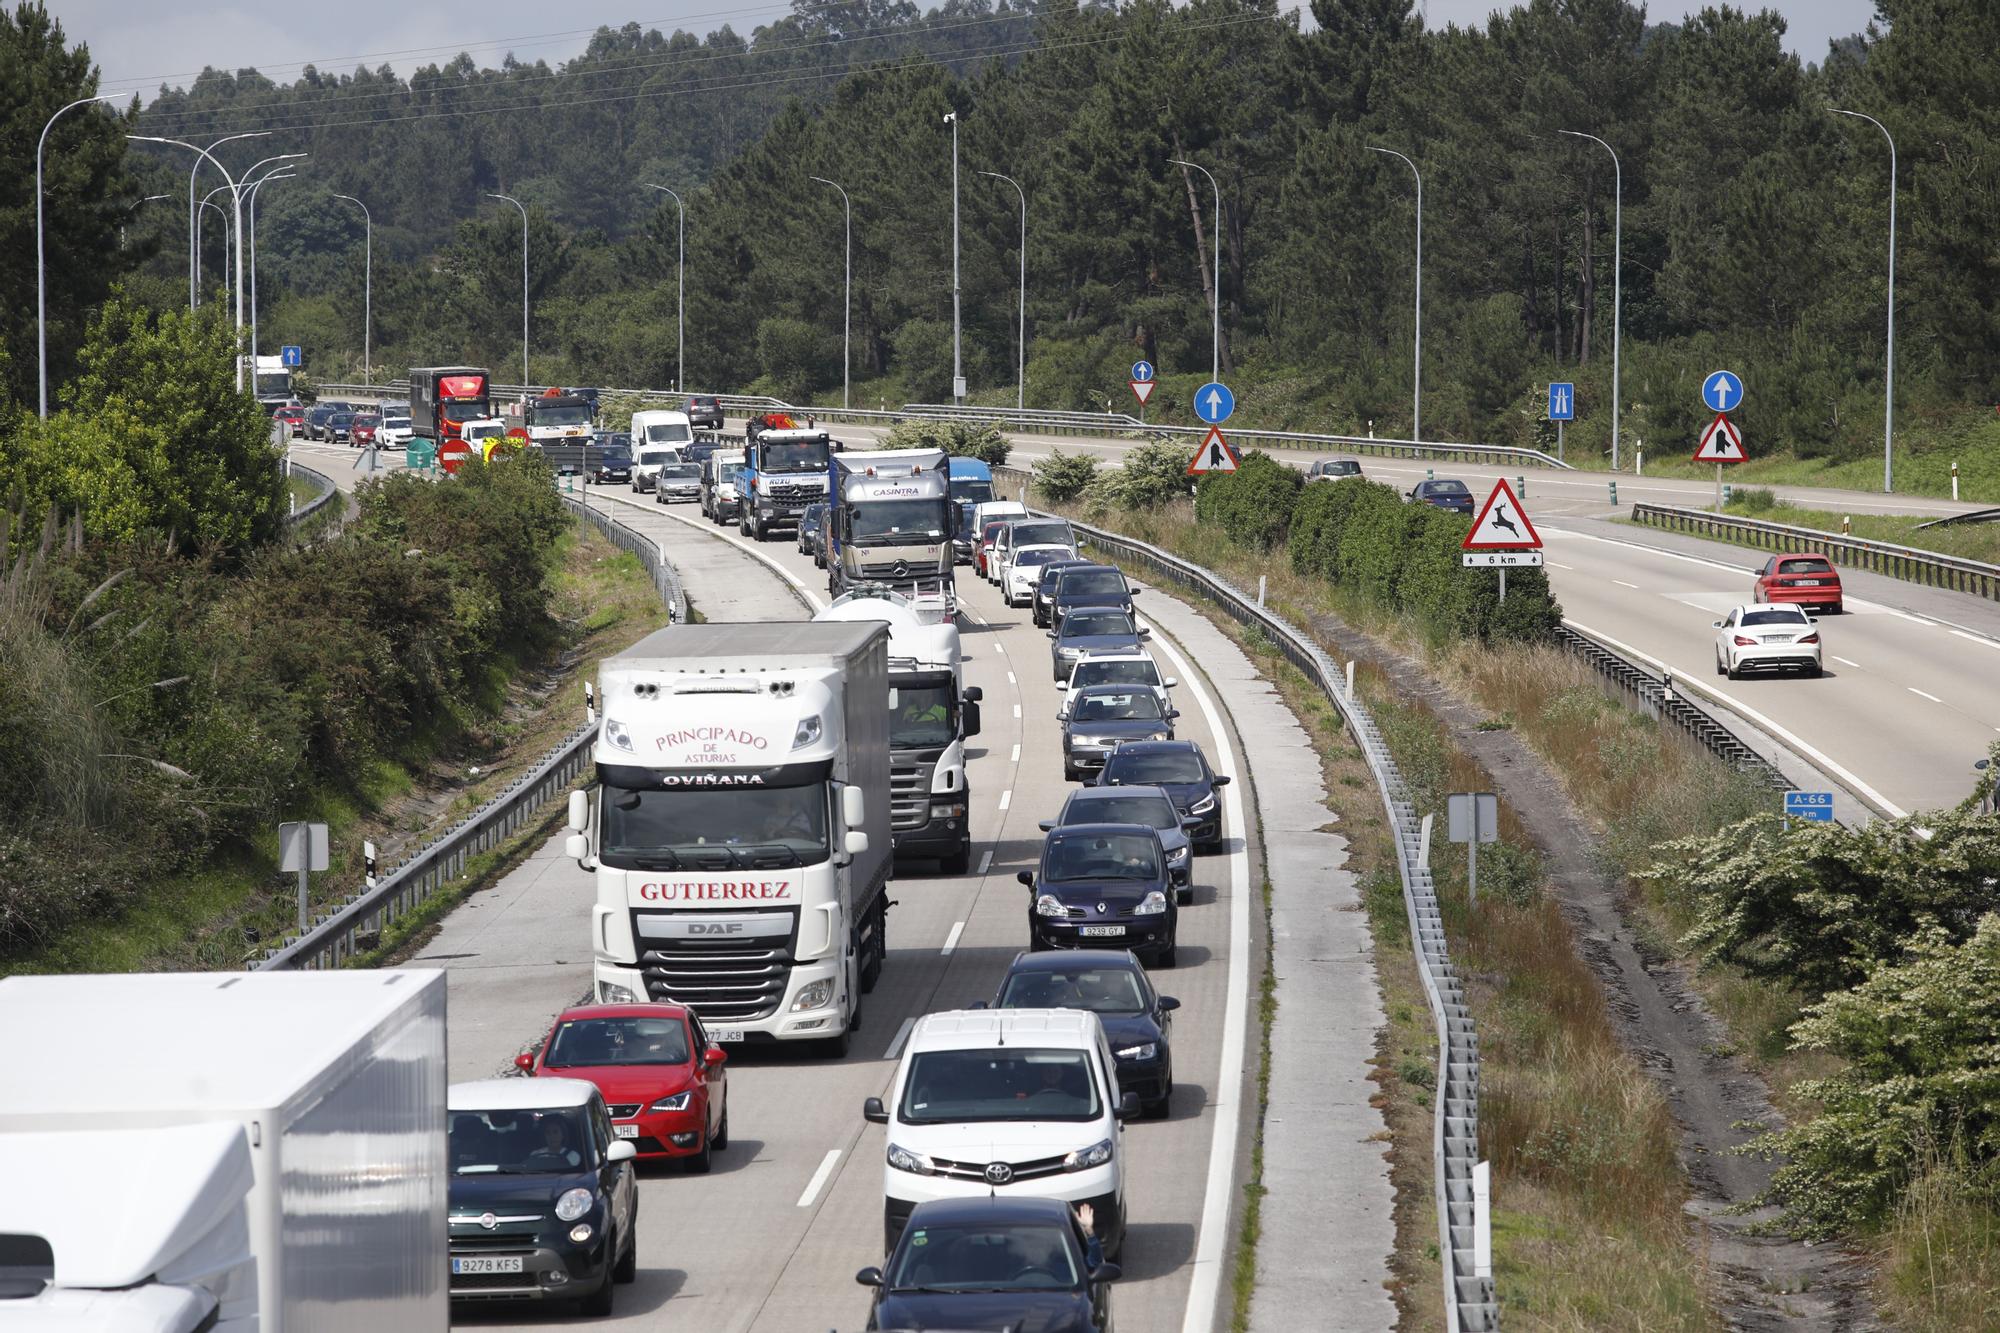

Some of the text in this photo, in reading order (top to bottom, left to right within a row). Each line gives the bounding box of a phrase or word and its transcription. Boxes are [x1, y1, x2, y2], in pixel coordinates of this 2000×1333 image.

[873, 488, 919, 496] CASINTRA
[1489, 556, 1517, 564] 6 km
[656, 727, 768, 751] PRINCIPADO
[703, 743, 718, 753] DE
[685, 754, 737, 763] ASTURIAS
[663, 773, 765, 786] OVIÑANA
[1794, 794, 1826, 804] A-66
[1803, 810, 1817, 818] km
[640, 881, 792, 901] GUTIERREZ
[688, 923, 743, 935] DAF
[1087, 927, 1124, 936] 9239 GYJ
[725, 1031, 742, 1040] JCB
[617, 1126, 637, 1137] JHL
[462, 1258, 520, 1271] 9278 KFS
